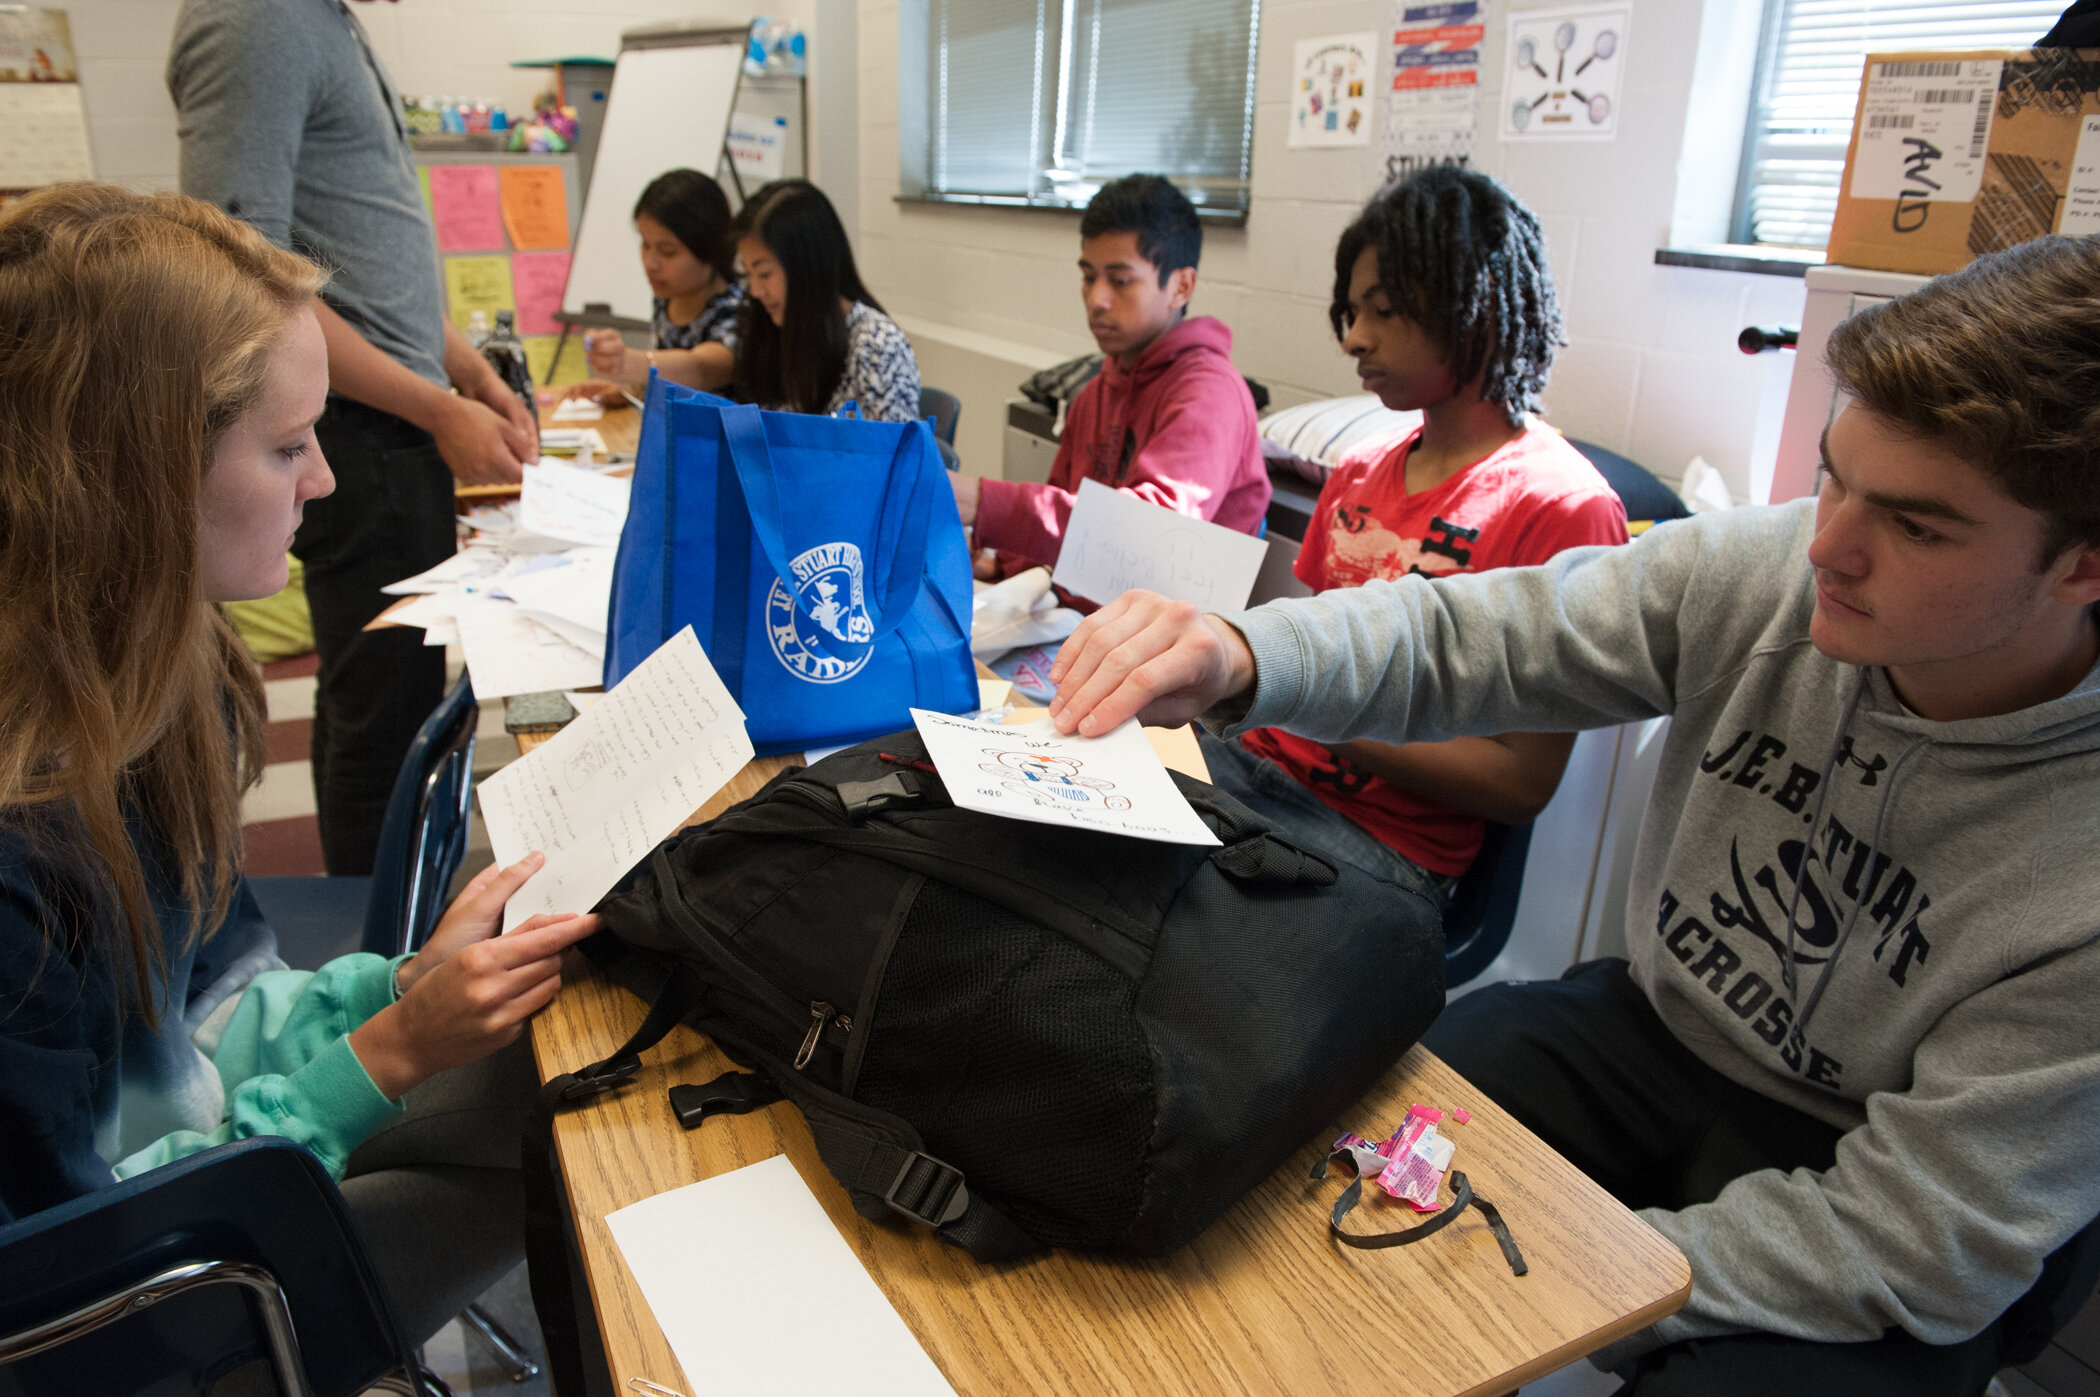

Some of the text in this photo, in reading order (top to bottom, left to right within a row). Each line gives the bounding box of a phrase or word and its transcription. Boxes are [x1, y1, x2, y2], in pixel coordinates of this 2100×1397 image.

[1892, 137, 1944, 234] AVID
[793, 545, 843, 581] STUART
[1024, 740, 1063, 749] we
[1700, 730, 1821, 824] J.E.B.
[976, 787, 1003, 799] all
[1033, 797, 1084, 813] have
